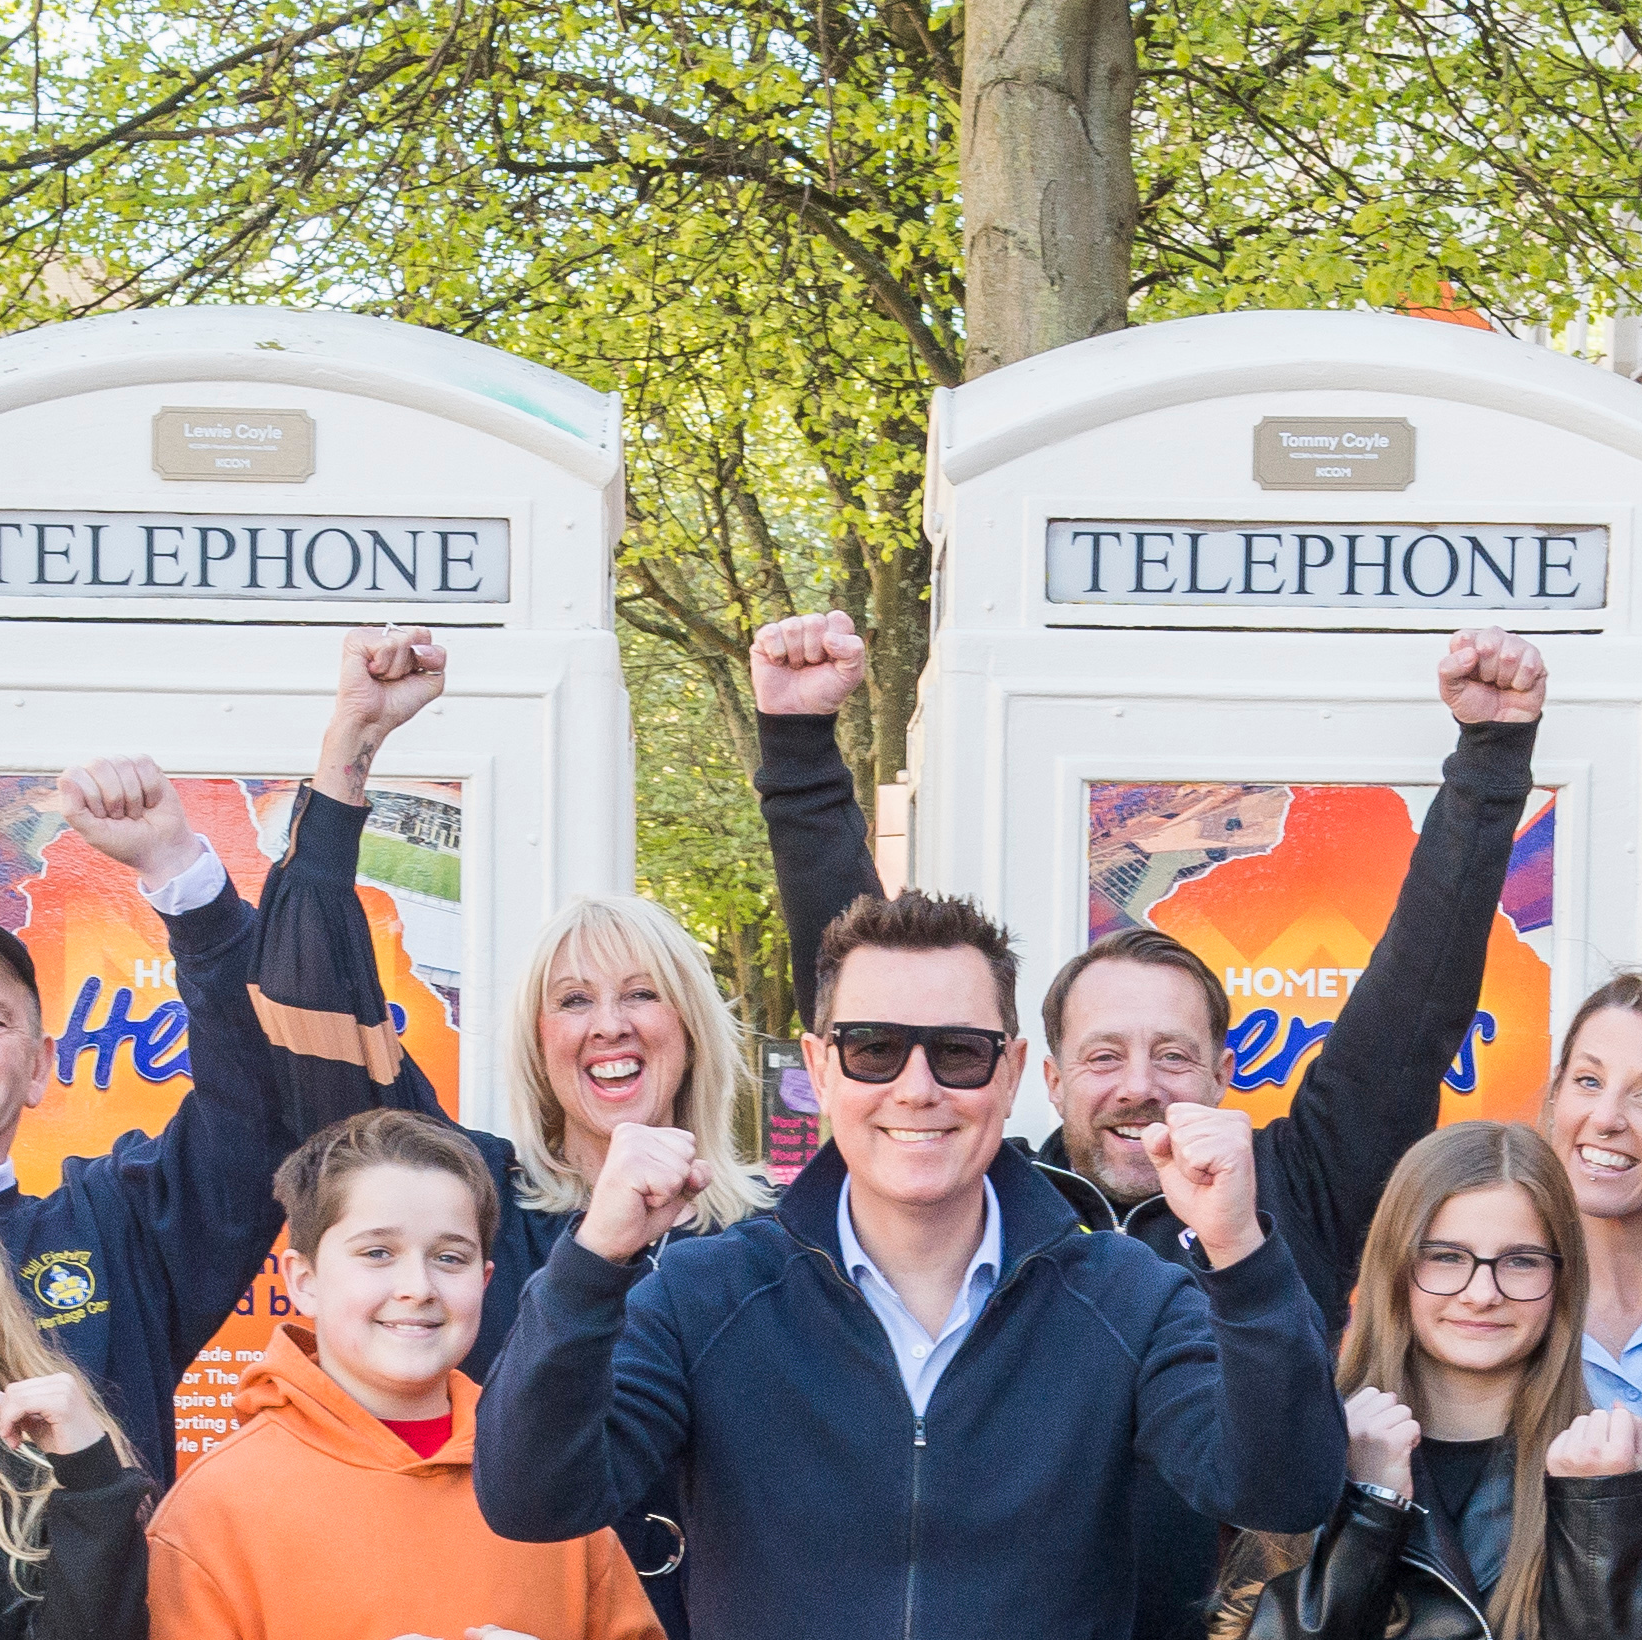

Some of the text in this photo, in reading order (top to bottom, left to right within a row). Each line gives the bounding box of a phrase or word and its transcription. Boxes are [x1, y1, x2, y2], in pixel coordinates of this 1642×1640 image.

[183, 423, 283, 442] Lewie Coyle
[1279, 432, 1390, 451] Tommy Coyle
[1315, 467, 1352, 477] KCOM
[1071, 531, 1582, 598] TELEPHONE
[204, 1368, 239, 1384] The
